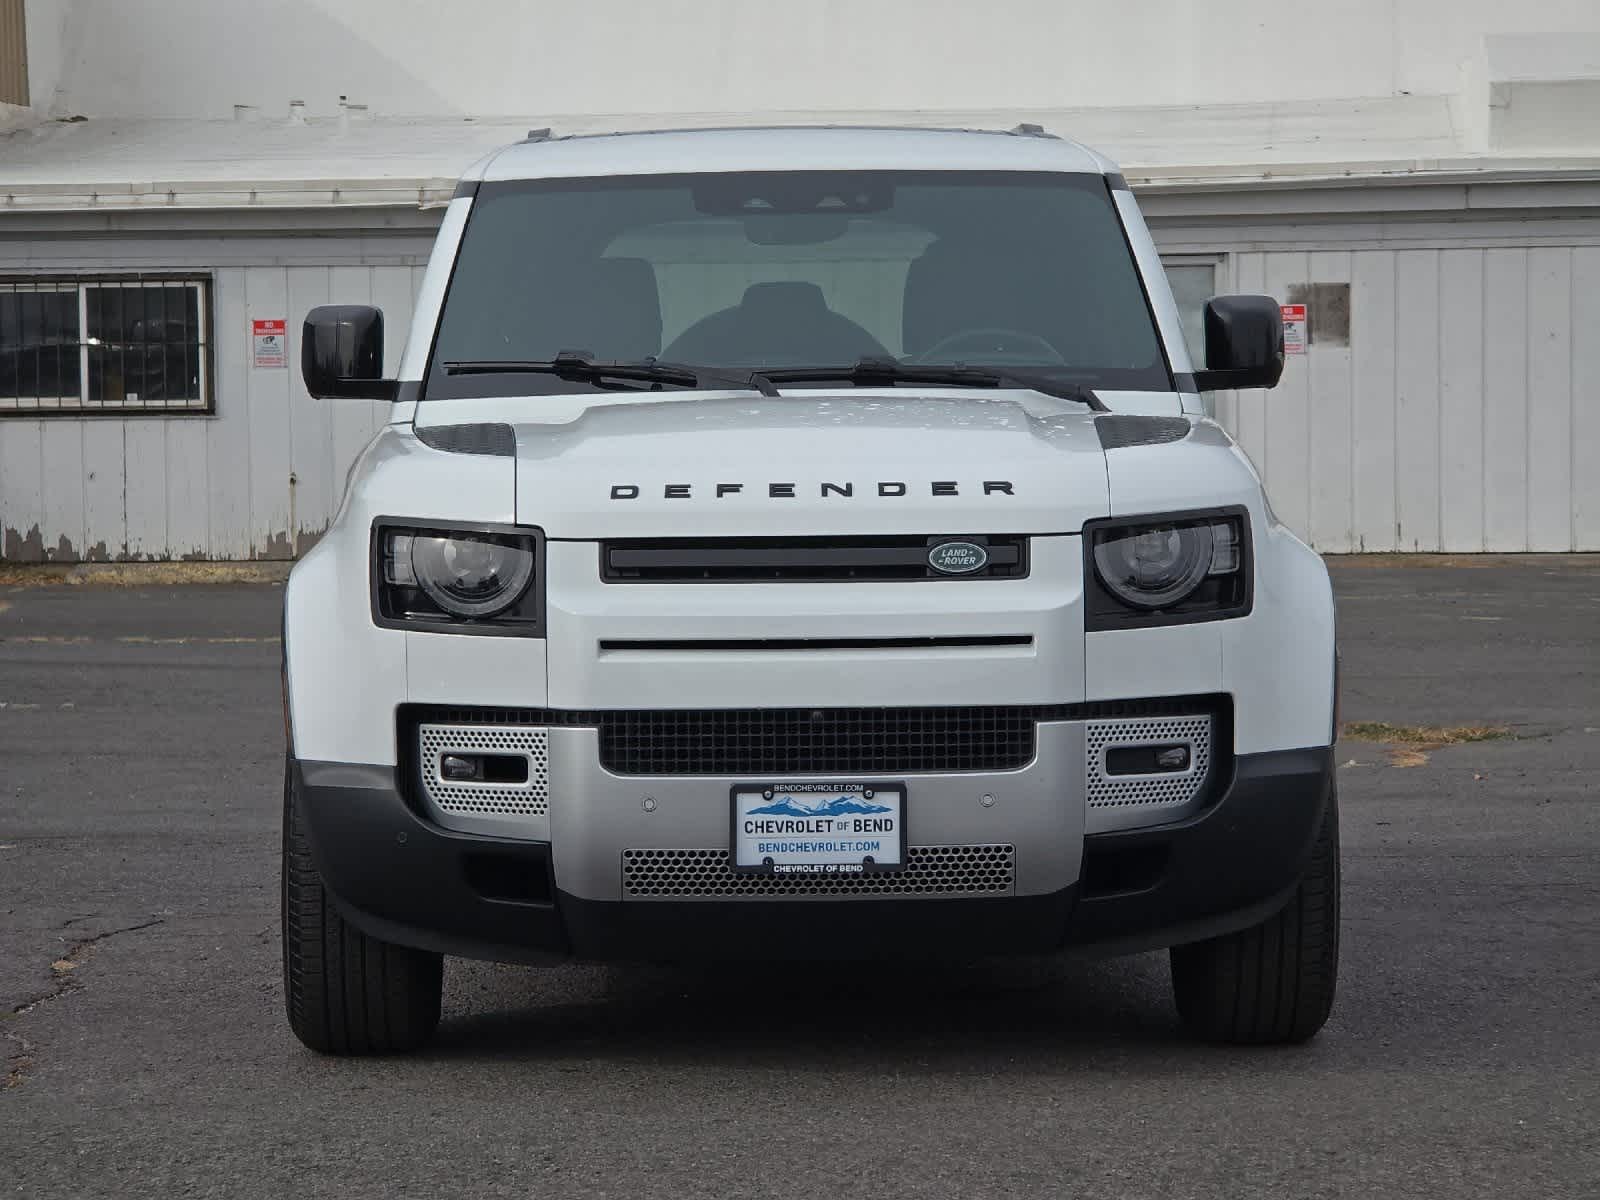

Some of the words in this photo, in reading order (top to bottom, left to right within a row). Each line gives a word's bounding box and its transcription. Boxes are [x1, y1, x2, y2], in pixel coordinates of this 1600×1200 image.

[610, 480, 1016, 500] DEFENDER
[773, 784, 864, 792] BENDCHEVROLET.COM
[744, 819, 833, 834] CHEVROLET
[836, 821, 849, 831] OF
[853, 818, 893, 833] BEND
[758, 841, 880, 853] BENDCHEVROLET.COM
[773, 865, 825, 873] CHEVROLET
[825, 865, 838, 873] OF
[839, 864, 863, 872] BEND
